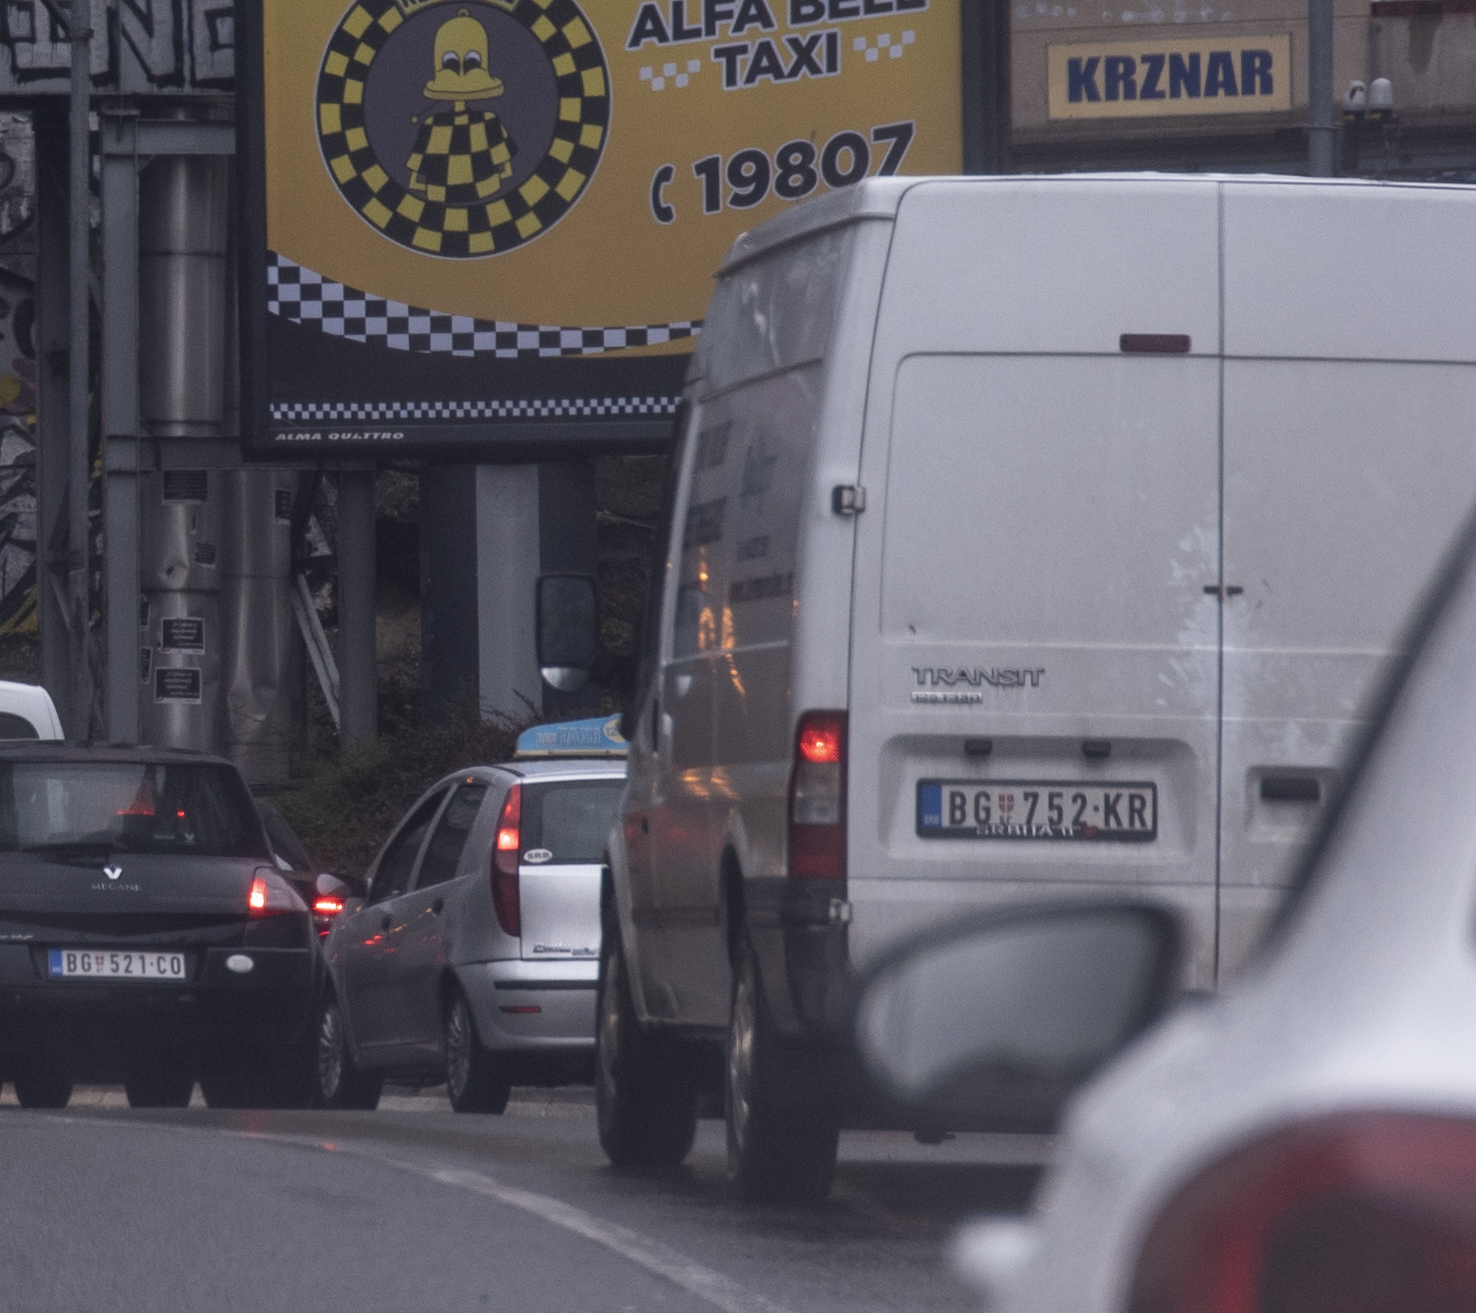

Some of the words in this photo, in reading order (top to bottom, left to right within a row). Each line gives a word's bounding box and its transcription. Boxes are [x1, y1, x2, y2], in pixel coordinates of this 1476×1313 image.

[712, 30, 841, 91] TAXI
[1067, 49, 1275, 104] KRZNAR
[693, 122, 916, 214] 19807
[275, 431, 322, 441] ALMA
[911, 666, 1046, 688] TRANSIT
[949, 791, 991, 826] BG
[66, 952, 92, 973] BG
